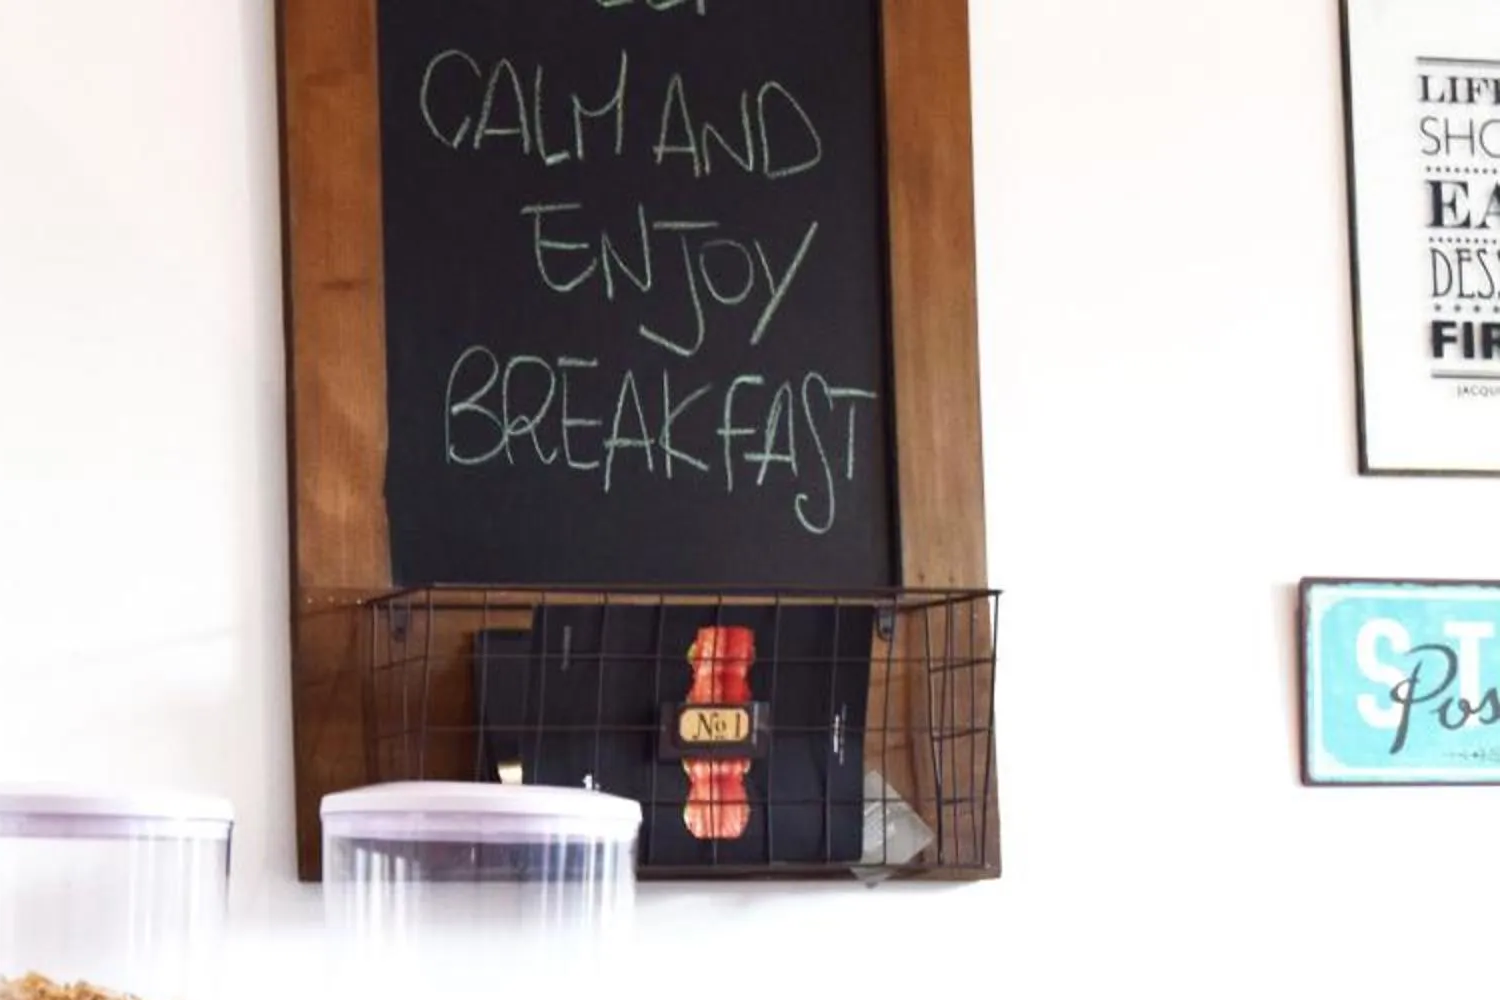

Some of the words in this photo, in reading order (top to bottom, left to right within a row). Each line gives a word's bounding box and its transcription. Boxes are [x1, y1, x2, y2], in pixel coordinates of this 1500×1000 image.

[419, 48, 627, 166] CALM
[653, 73, 821, 179] AND
[520, 203, 818, 356] ENJOY
[1430, 247, 1500, 299] DES
[446, 345, 878, 534] BREAKFAST
